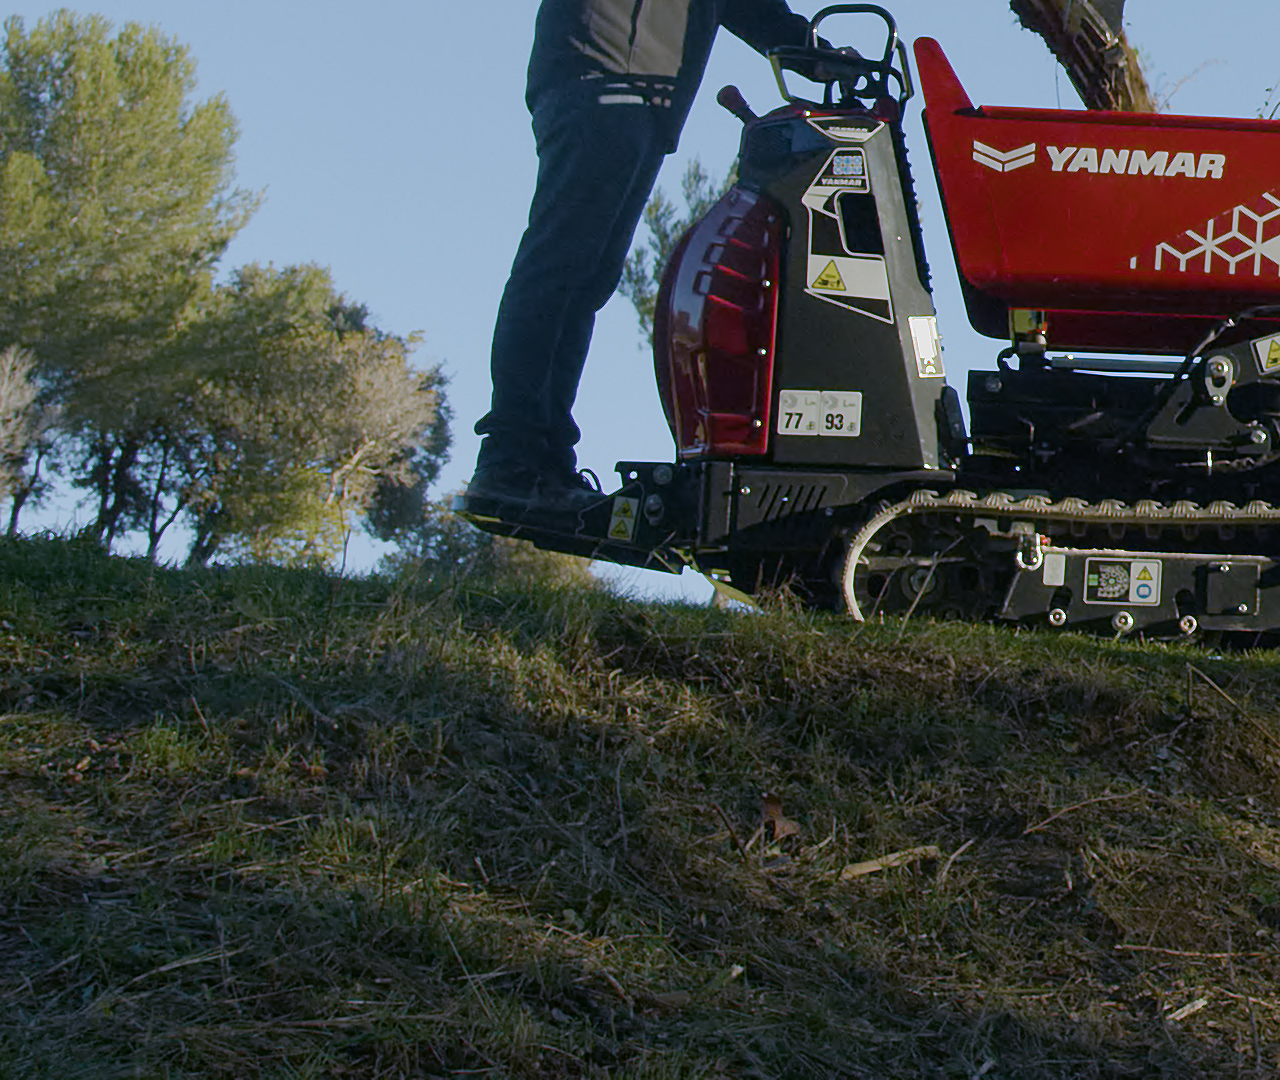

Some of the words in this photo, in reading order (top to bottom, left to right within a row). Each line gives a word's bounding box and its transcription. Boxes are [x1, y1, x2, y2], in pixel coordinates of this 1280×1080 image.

[1046, 145, 1226, 179] YANMAR
[821, 178, 862, 187] YANMAR
[784, 412, 803, 429] 77
[825, 413, 844, 431] 93
